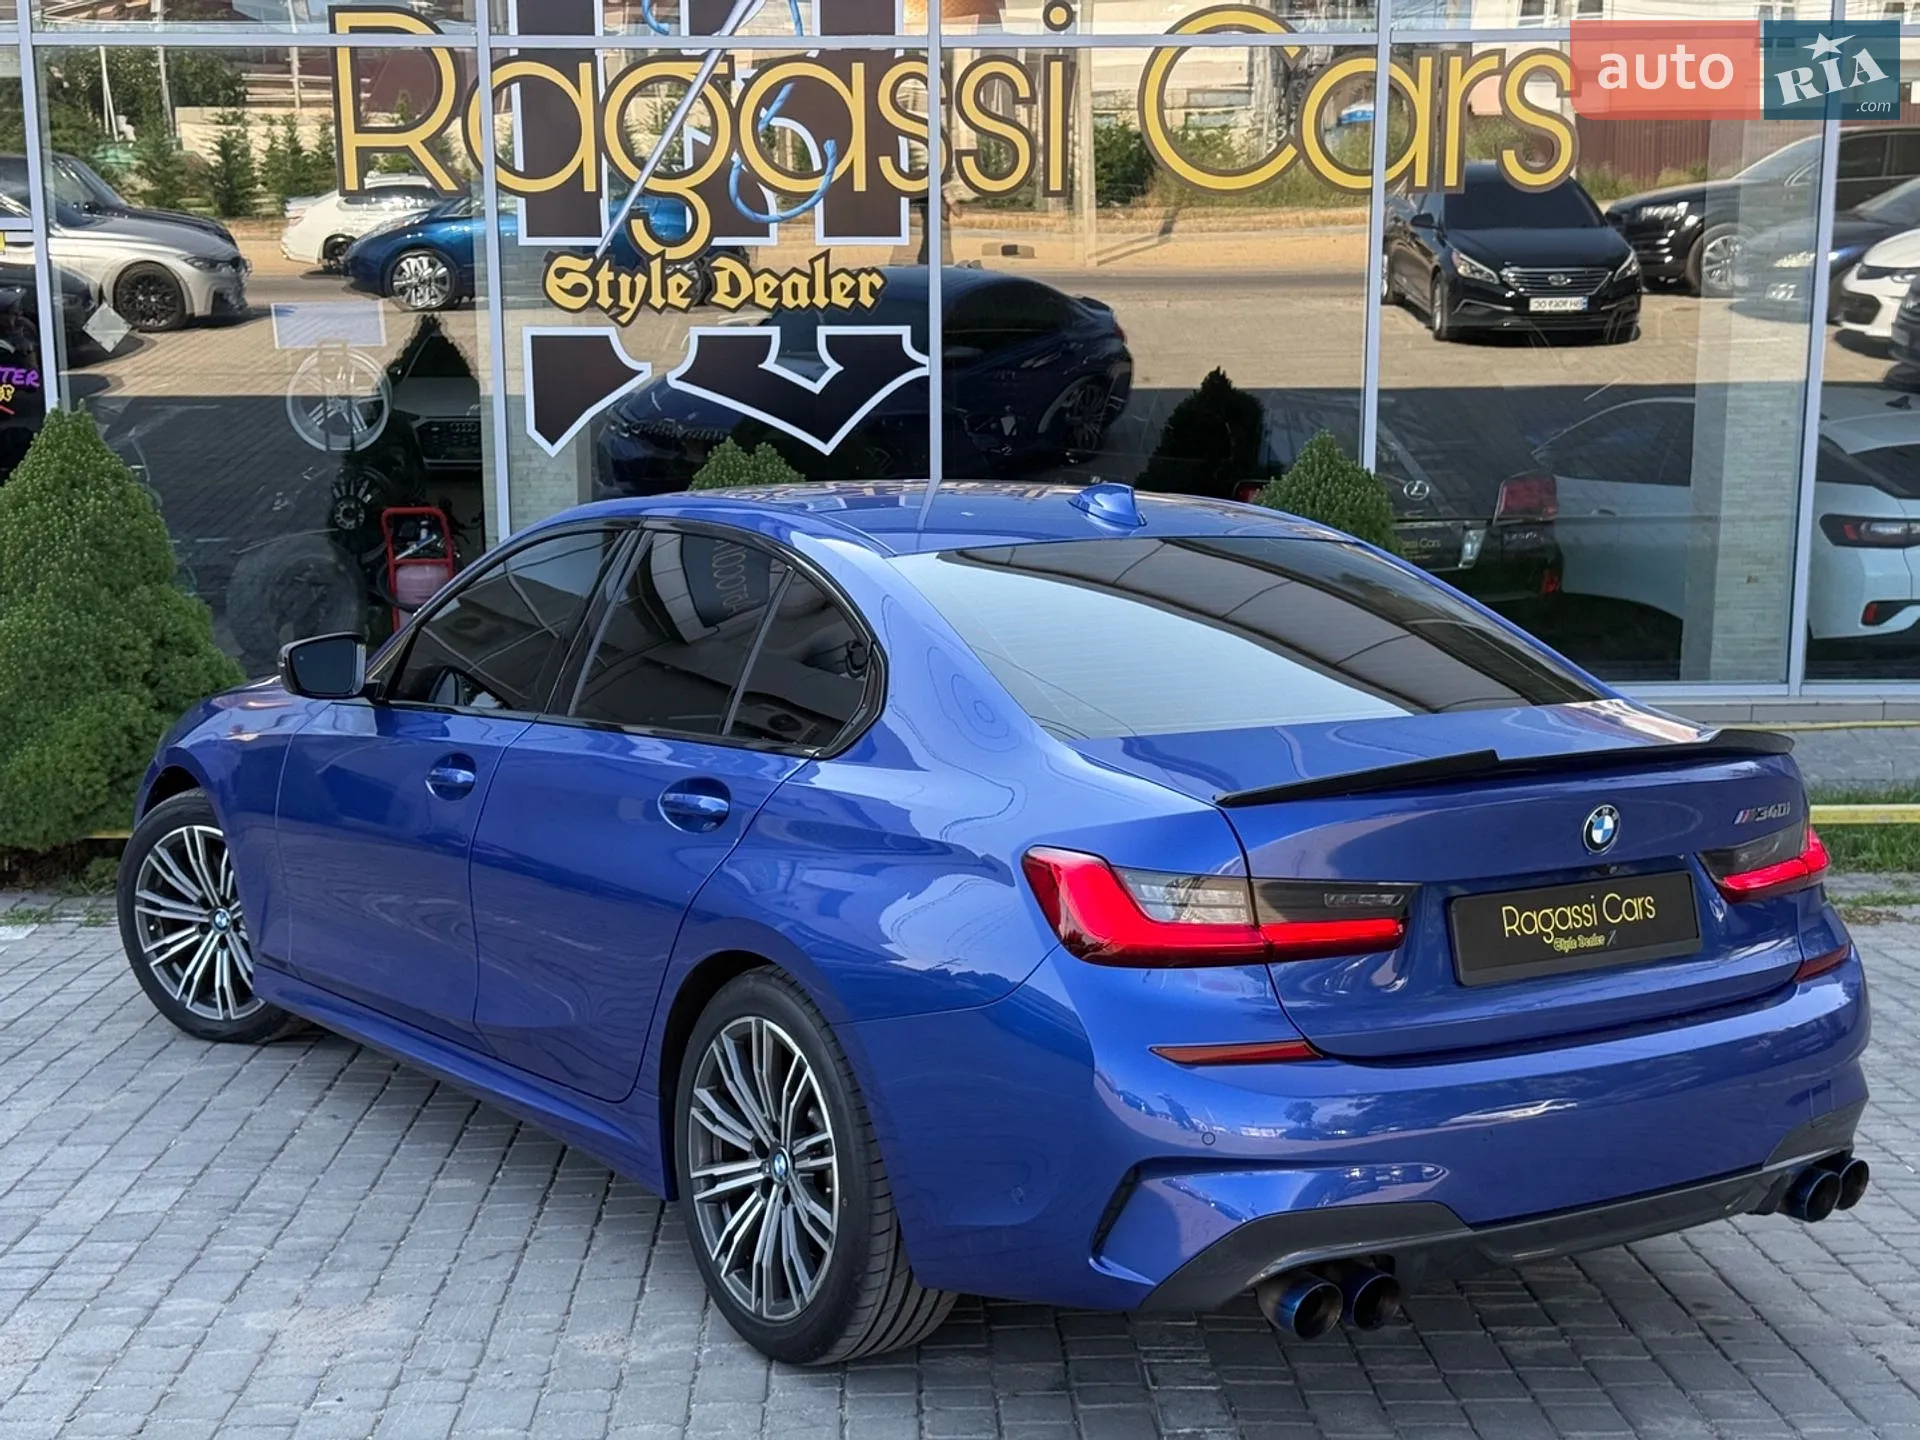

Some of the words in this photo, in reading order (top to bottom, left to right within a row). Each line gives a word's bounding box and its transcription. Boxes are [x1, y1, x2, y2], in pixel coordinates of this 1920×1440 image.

[330, 2, 1072, 261] Ragassi
[1140, 5, 1580, 193] Cars
[544, 251, 694, 325] Style
[708, 250, 887, 313] Dealer
[1502, 894, 1598, 944] Ragassi
[1602, 893, 1656, 924] Cars
